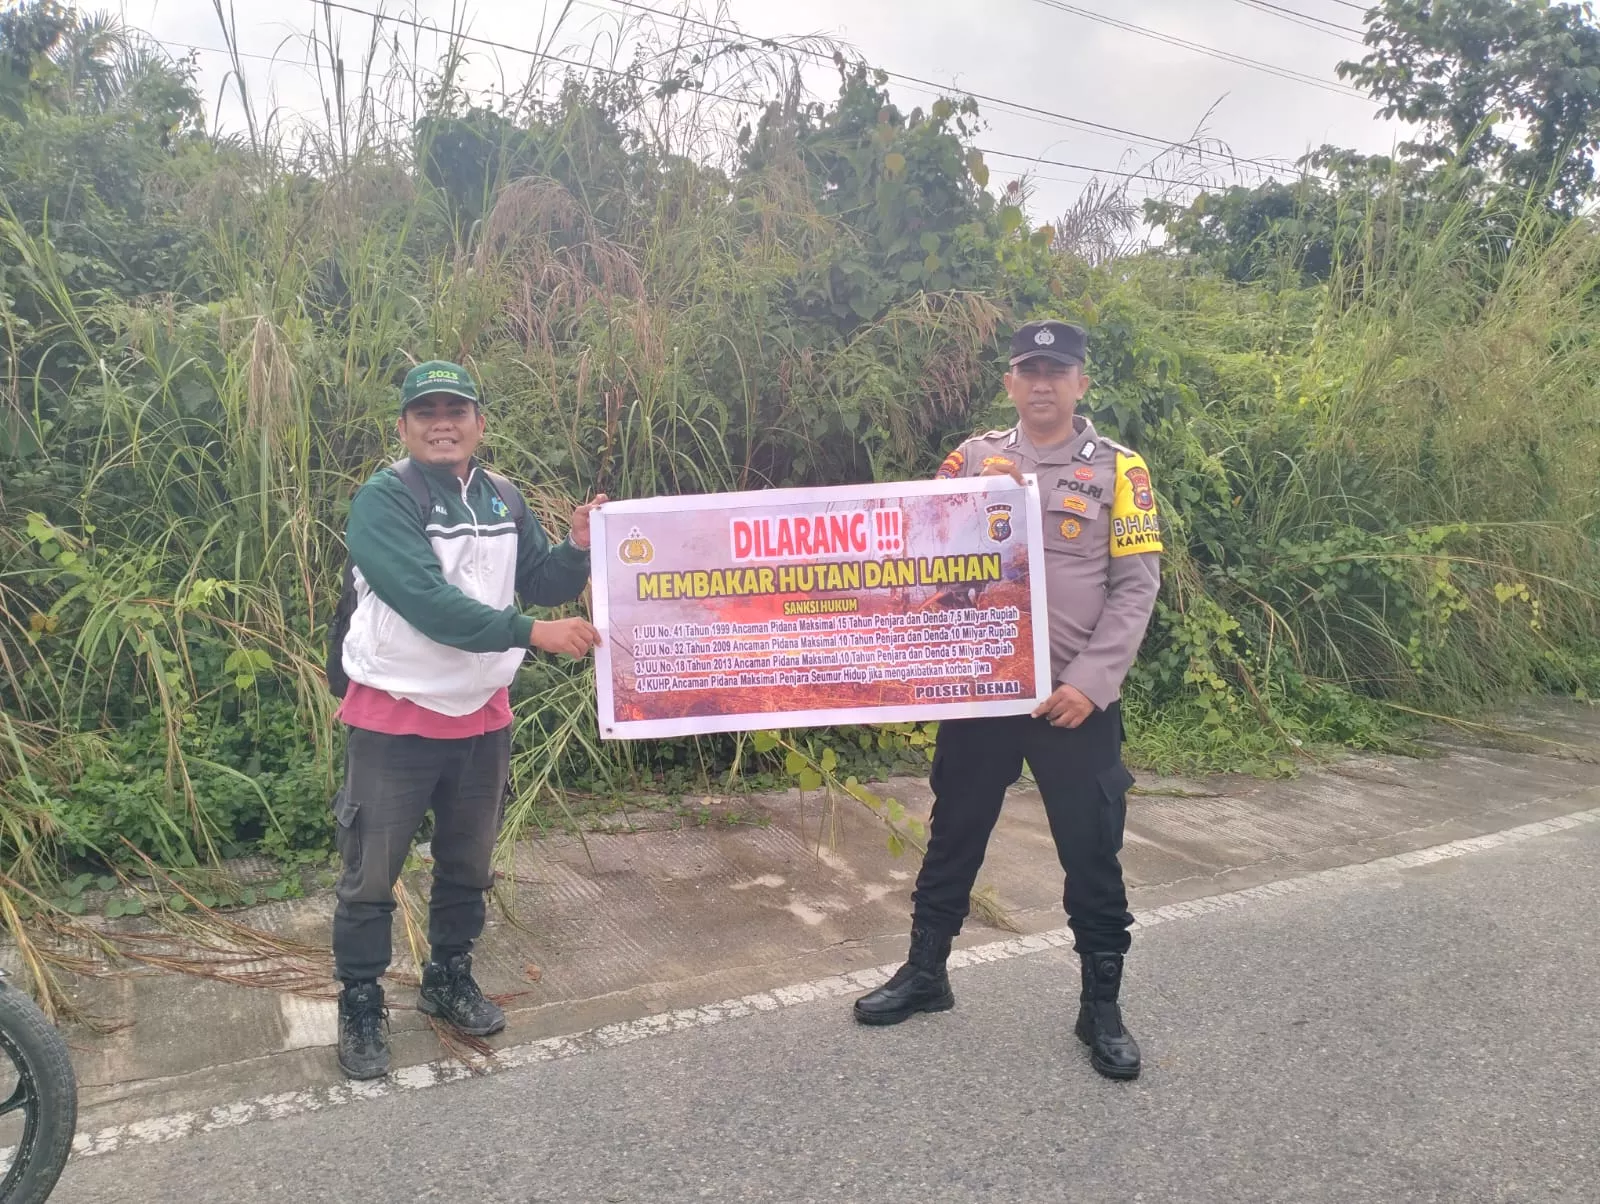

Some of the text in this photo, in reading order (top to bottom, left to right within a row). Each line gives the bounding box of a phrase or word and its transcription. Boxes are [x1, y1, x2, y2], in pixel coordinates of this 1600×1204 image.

[1057, 479, 1103, 498] POLRI
[733, 511, 900, 558] DILARANG !!!
[638, 553, 1001, 600] MEMBAKAR HUTAN DAN LAHAN
[784, 598, 857, 615] SANKSI HUKUM
[634, 608, 1017, 638] 1. UU No. 41 Tahun 1999 Ancaman Pidana Maksimal 15 Tahun Penjara dan Denda 7,5 Milyar Rupiah
[635, 625, 1016, 656] 2. UU No. 32 Tahun 2009 Ancaman Pidana Maksimal 10 Tahun Penjara dan Denda 10 Milyar Rupiah
[636, 643, 1012, 673] 3. UU No. 18 Tahun 2013 Ancaman Pidana Maksimal 10 Tahun Penjara dan Denda 5 Milyar Rupiah
[637, 679, 645, 691] 4.
[672, 677, 708, 689] Ancaman
[711, 675, 738, 687] Pidana
[740, 673, 777, 686] Maksimal
[779, 671, 809, 686] Penjara
[811, 670, 840, 682] Seumur
[843, 668, 867, 682] Hidup
[868, 667, 882, 682] jika
[884, 663, 944, 679] mengakibatkan
[945, 663, 971, 674] korban
[974, 662, 989, 676] jiwa
[915, 682, 1019, 698] POLSEK BENAI
